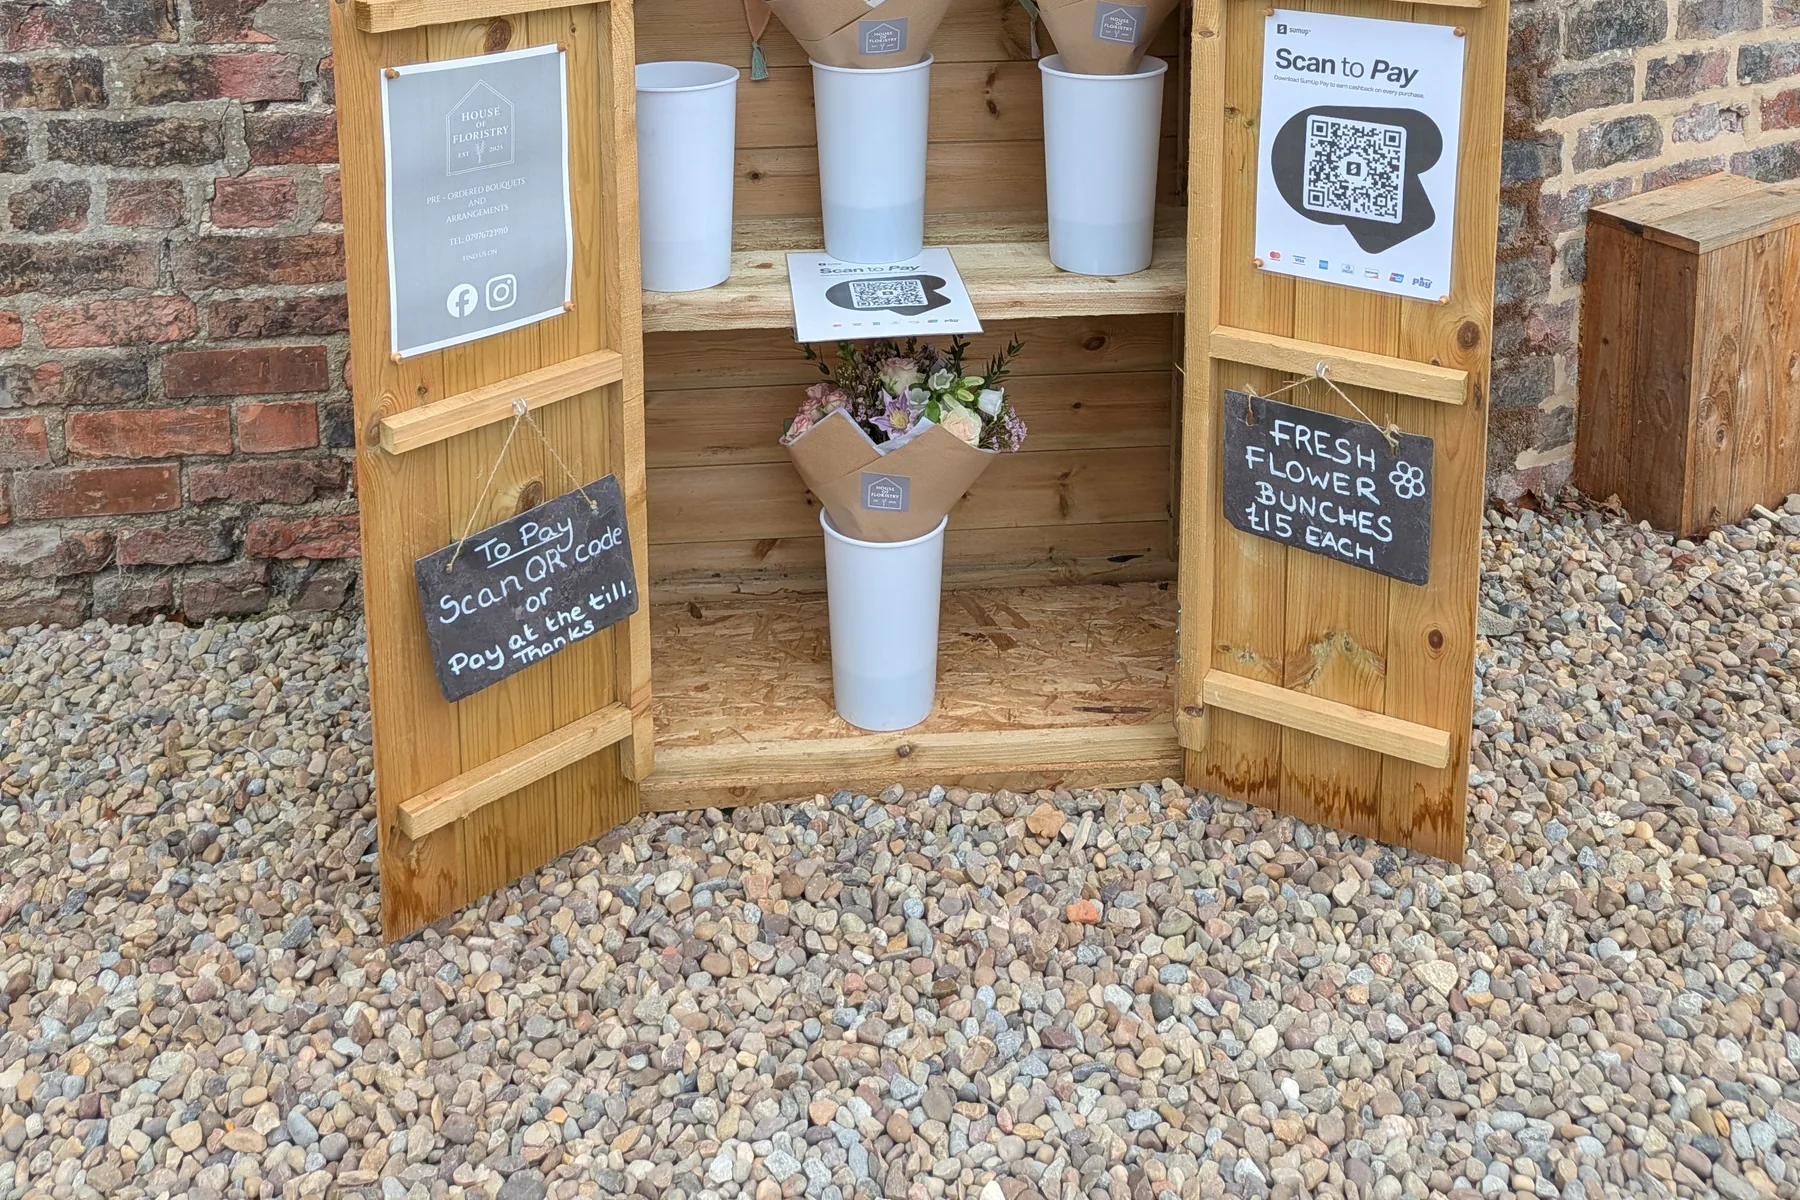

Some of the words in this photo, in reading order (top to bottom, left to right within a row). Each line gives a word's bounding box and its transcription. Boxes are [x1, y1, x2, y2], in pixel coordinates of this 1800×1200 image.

[1104, 23, 1133, 31] FLORISTRY
[1109, 16, 1129, 24] HOUSE
[1275, 48, 1336, 75] Scan
[1341, 57, 1365, 78] to
[1370, 59, 1419, 89] Pay
[1274, 74, 1299, 83] Download
[1300, 78, 1319, 86] SumUp
[1319, 80, 1329, 88] Pay
[1349, 84, 1374, 92] cashback
[1398, 90, 1425, 99] purchase.
[461, 106, 500, 121] HOUSE
[475, 120, 487, 128] OF
[452, 125, 509, 144] FLORISTRY
[426, 195, 441, 204] PRE
[447, 186, 484, 200] ORDERED
[485, 177, 526, 192] BOUQUETS
[468, 196, 487, 207] AND
[446, 203, 509, 224] ARRANGEMENTS
[449, 237, 465, 246] TEL:
[465, 226, 509, 242] 07976723910
[462, 253, 478, 262] FIND
[479, 250, 487, 258] US
[487, 248, 498, 256] ON
[1269, 419, 1376, 472] FRESH
[1245, 445, 1381, 505] FLOWER
[1255, 481, 1393, 542] BUNCHES
[474, 537, 511, 562] To
[519, 517, 574, 553] Pay
[1245, 502, 1293, 538] £15
[1305, 526, 1374, 564] EACH
[439, 575, 523, 623] Scan
[525, 549, 567, 582] QR
[574, 526, 623, 563] code
[525, 586, 553, 613] or
[448, 644, 505, 675] Pay
[508, 624, 539, 650] at
[545, 605, 587, 632] the
[589, 580, 632, 611] till.
[512, 619, 595, 664] Thanks
